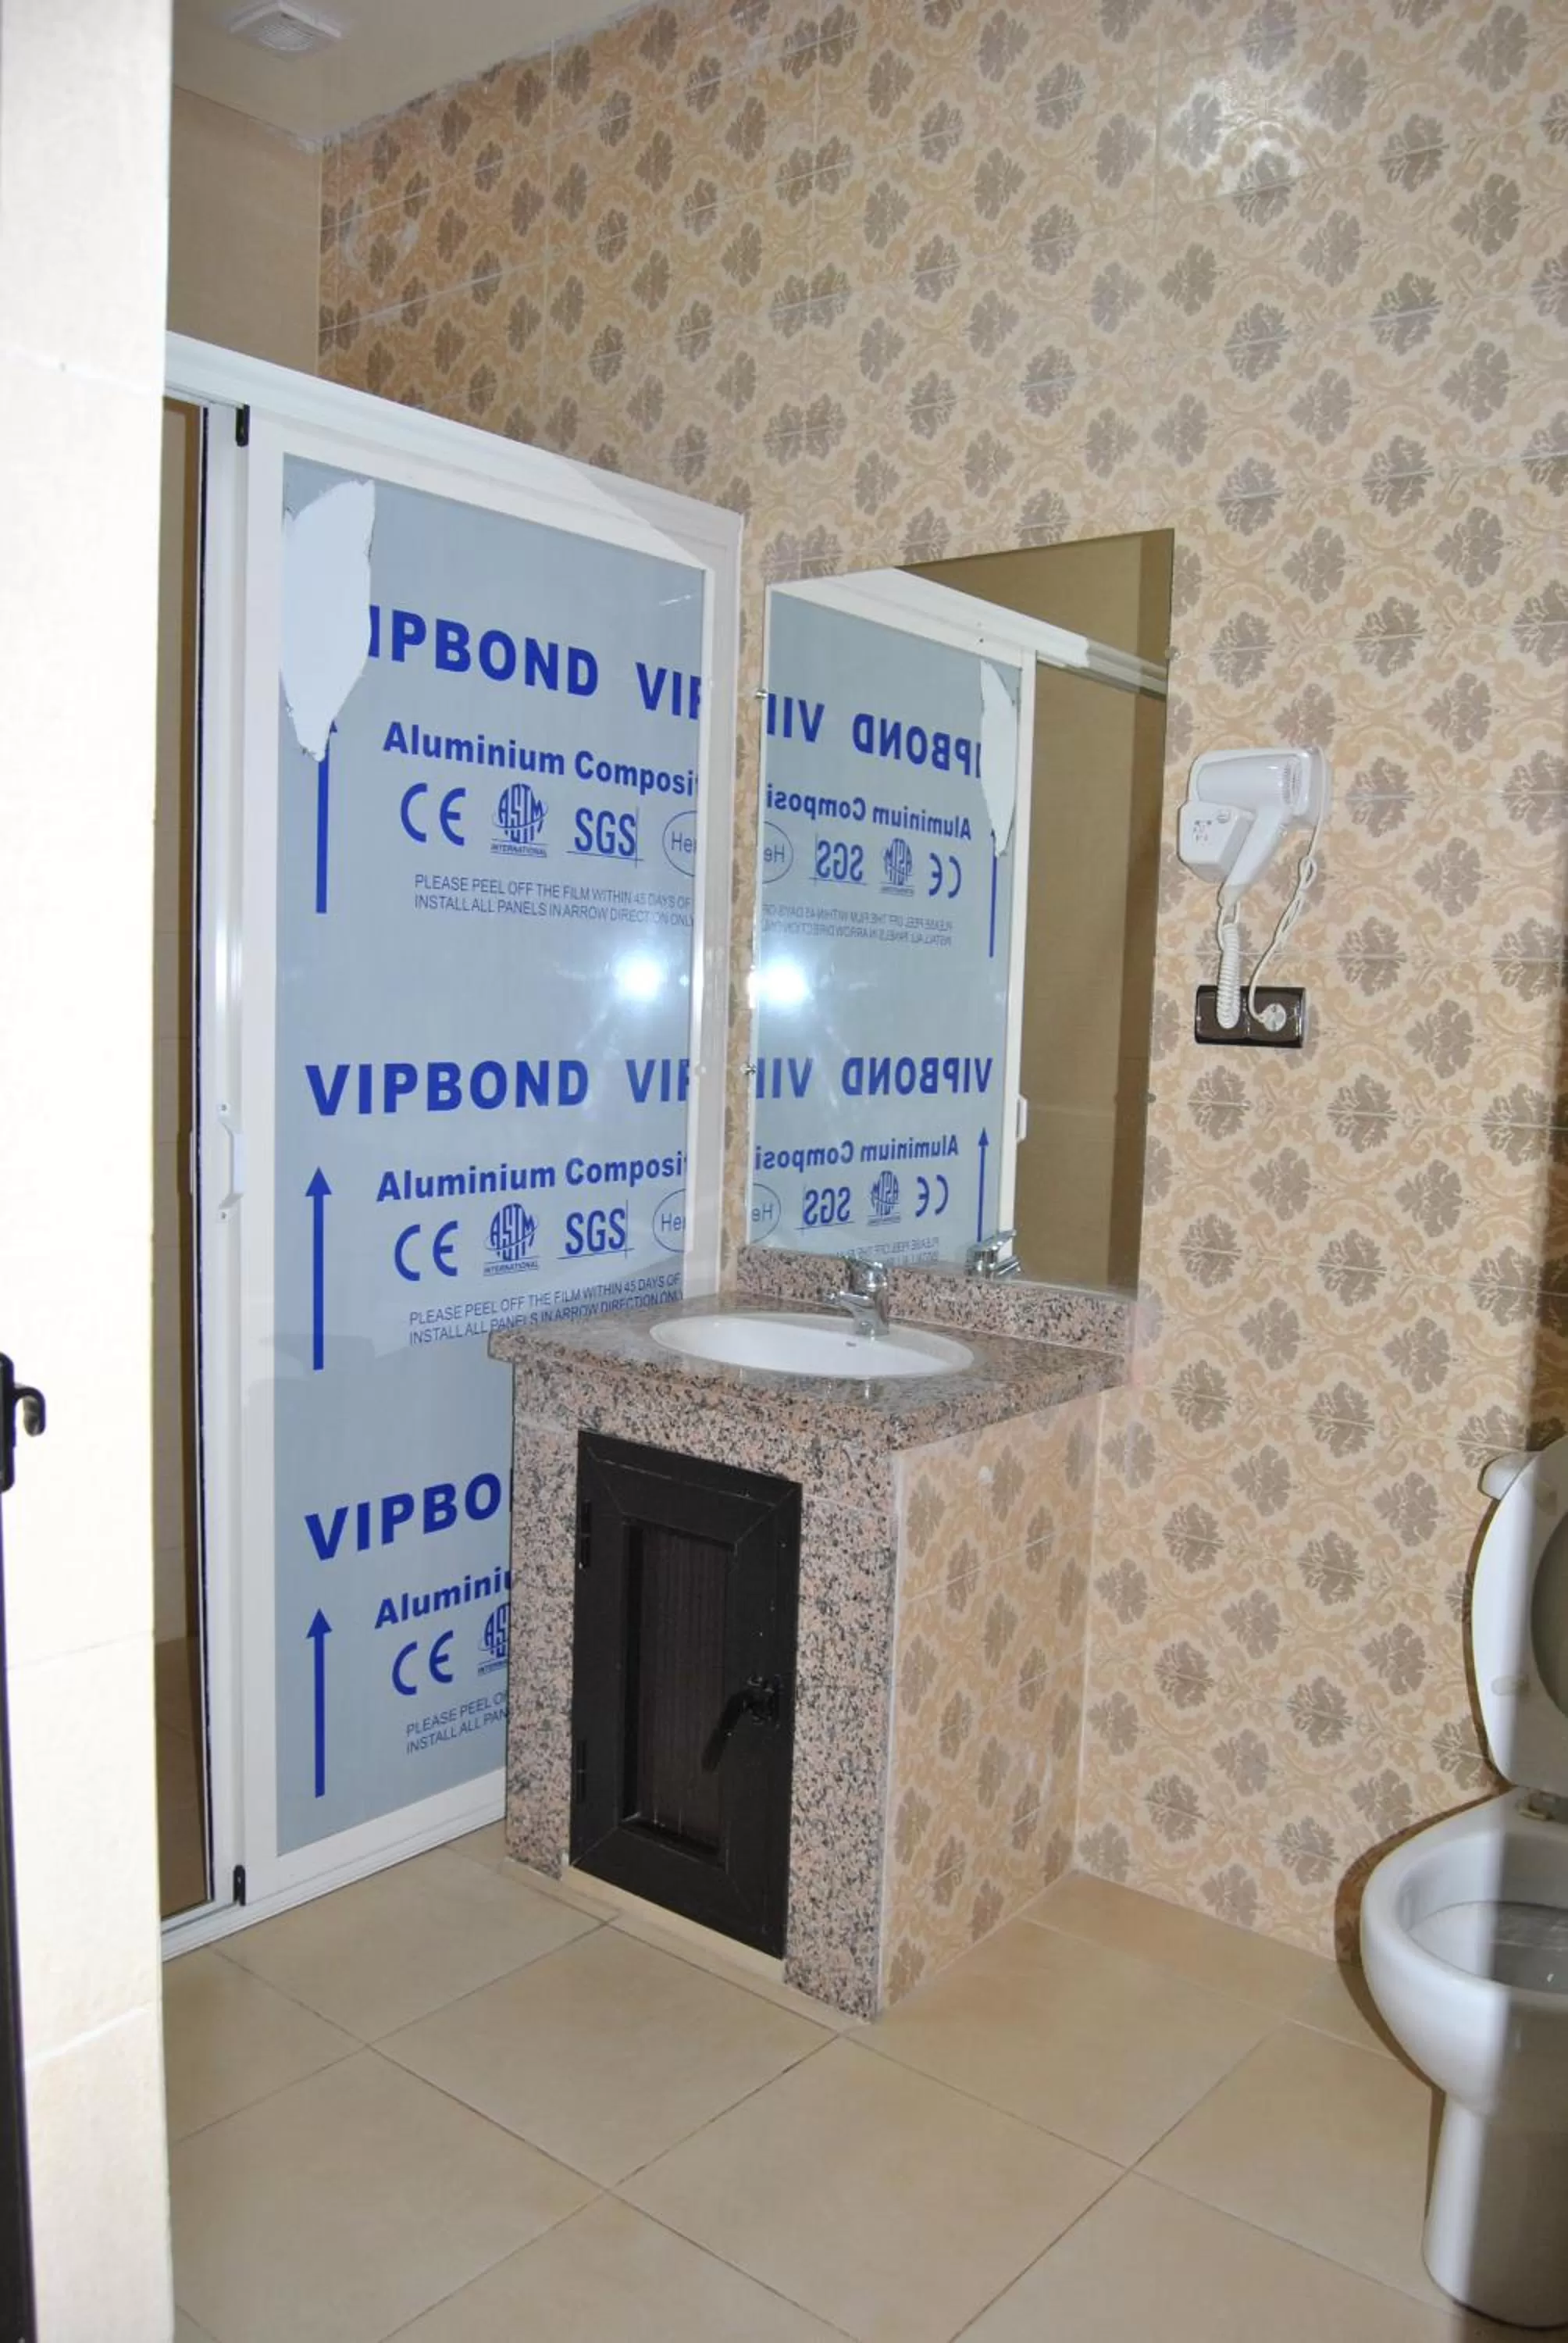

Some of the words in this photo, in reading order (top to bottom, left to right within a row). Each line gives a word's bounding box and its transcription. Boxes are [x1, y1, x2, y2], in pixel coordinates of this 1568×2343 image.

[383, 721, 565, 776] Aluminium
[575, 751, 698, 796] Composi
[401, 783, 465, 846] CE
[497, 783, 543, 843] ASTM
[575, 807, 636, 857] SGS
[415, 874, 469, 891] PLEASE
[472, 879, 505, 894] PEEL
[508, 881, 534, 896] OFF
[537, 883, 560, 898] THE
[563, 885, 590, 900] FILM
[591, 888, 631, 904] WITHIN
[415, 895, 469, 911] INSTALL
[472, 899, 495, 913] ALL
[497, 900, 547, 916] PANELS
[549, 904, 561, 916] IN
[562, 904, 609, 919] ARROW
[305, 1059, 588, 1116] VIPBOND
[376, 1163, 555, 1202] Aluminium
[565, 1150, 687, 1188] Composi
[394, 1221, 458, 1282] CE
[490, 1203, 536, 1261] ASTM
[565, 1208, 625, 1255] SGS
[409, 1305, 462, 1325] PLEASE
[465, 1300, 497, 1318] PEEL
[501, 1296, 525, 1312] OFF
[529, 1293, 551, 1307] THE
[554, 1289, 581, 1303] FILM
[583, 1281, 622, 1300] WITHIN
[639, 1275, 665, 1291] DAYS
[667, 1272, 681, 1286] OF
[409, 1324, 462, 1345] INSTALL
[465, 1321, 487, 1336] ALL
[305, 1468, 513, 1561] VIPBO
[392, 1629, 454, 1696] CE
[406, 1708, 457, 1737] PLEASE
[460, 1697, 491, 1717] PEEL
[406, 1727, 457, 1756] INSTALL
[459, 1719, 481, 1736] ALL
